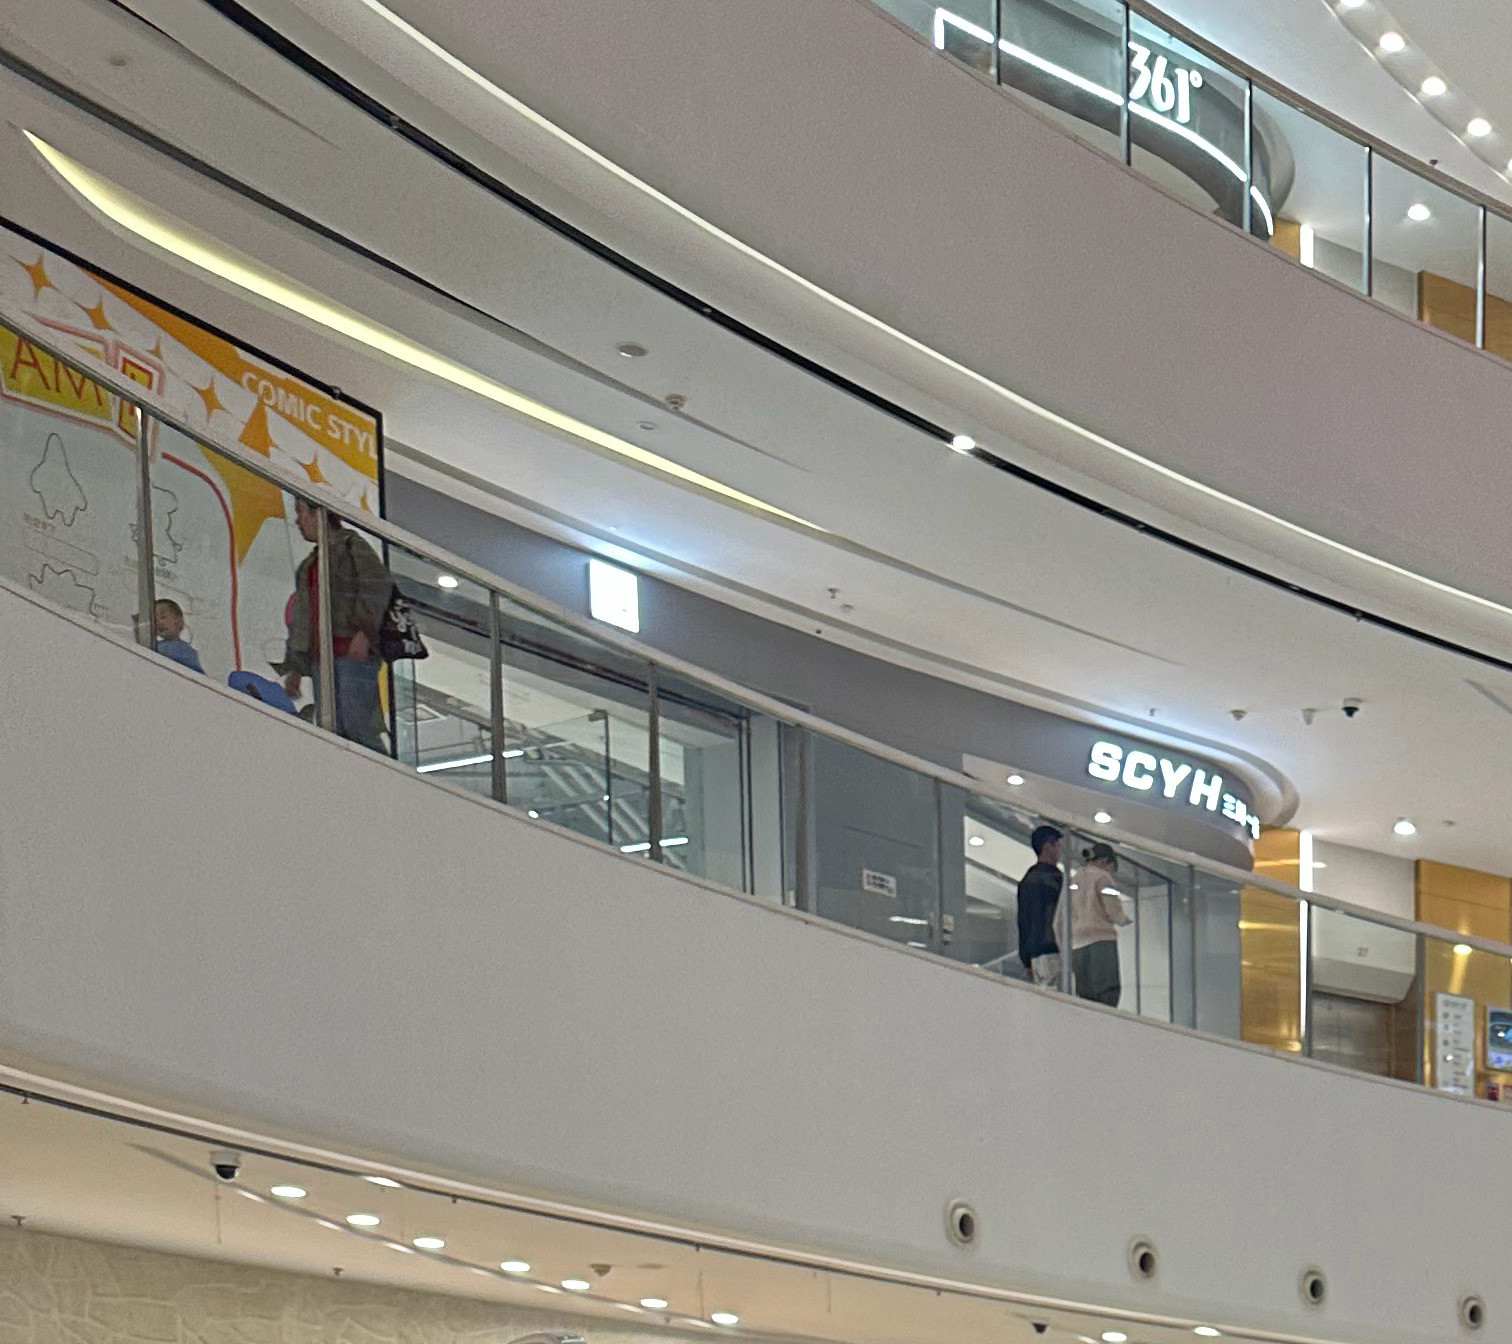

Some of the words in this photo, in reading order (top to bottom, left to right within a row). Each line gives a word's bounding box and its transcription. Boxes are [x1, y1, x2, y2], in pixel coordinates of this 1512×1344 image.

[1127, 41, 1203, 123] 361°
[241, 371, 321, 430] COMIC
[1088, 741, 1223, 811] SCYH
